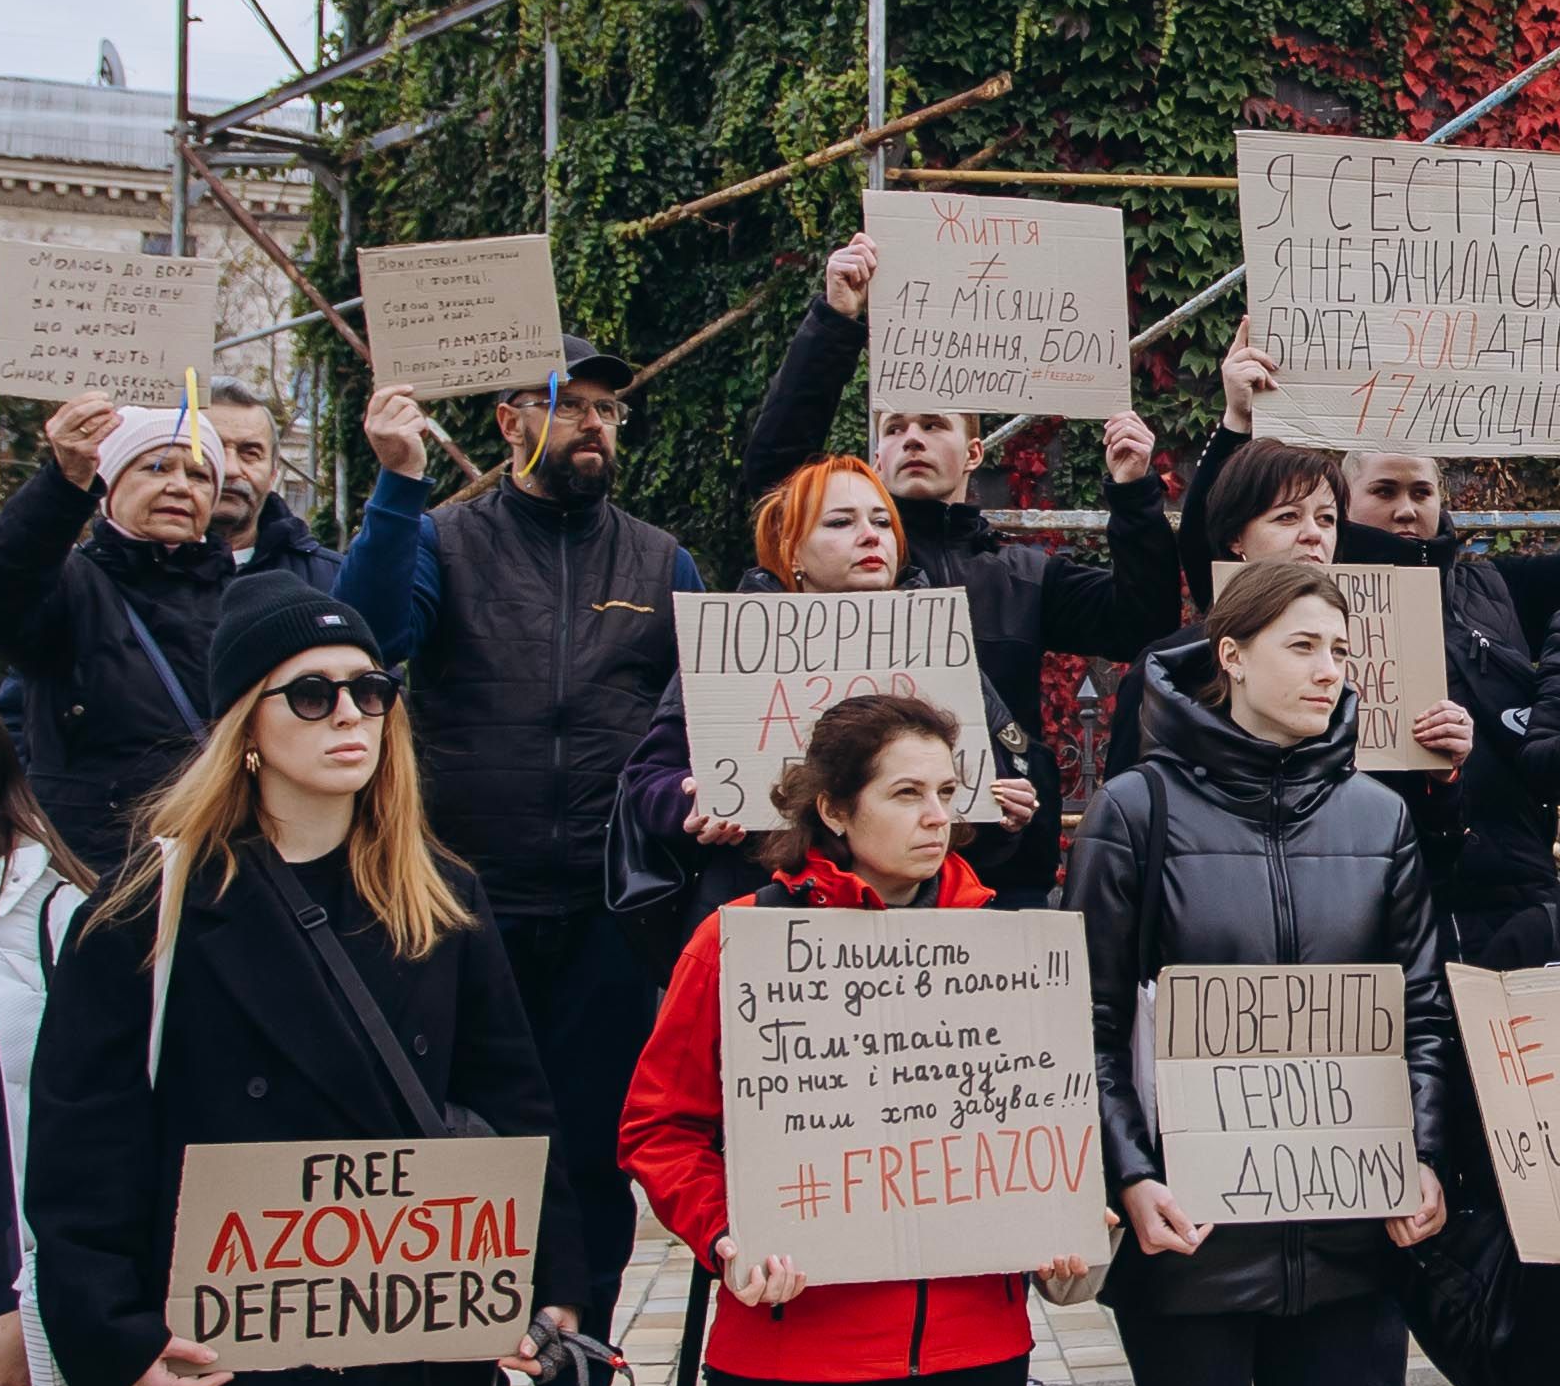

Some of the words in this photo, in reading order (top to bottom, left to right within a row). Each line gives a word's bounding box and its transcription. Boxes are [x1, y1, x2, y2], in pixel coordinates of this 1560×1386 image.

[1257, 154, 1294, 229] Я
[1328, 156, 1542, 235] СЕСТРА
[896, 281, 930, 319] 17
[1258, 237, 1295, 303] Я
[1310, 238, 1355, 303] НЕ
[1372, 238, 1502, 304] БАЧИЛА
[1265, 307, 1372, 372] БРАТА
[1383, 310, 1478, 371] 500
[1352, 370, 1415, 437] 17
[695, 592, 970, 674] ПОВЕРНІТЬ
[787, 920, 970, 972] Більшість
[738, 981, 756, 1022] з
[768, 980, 828, 1003] них
[844, 974, 903, 1016] досі
[916, 971, 931, 998] в
[945, 950, 1070, 996] полоні!!!
[1168, 974, 1393, 1057] ПОВЕРНІТЬ
[759, 1018, 1002, 1063] Пам'ятайте
[1489, 1016, 1554, 1086] НЕ
[737, 1076, 788, 1110] про
[799, 1074, 848, 1092] них
[869, 1067, 878, 1087] і
[893, 1050, 1055, 1094] нагадуйте
[785, 1114, 854, 1133] тим
[882, 1105, 937, 1124] хто
[950, 1073, 1092, 1129] забуває!!!
[1213, 1059, 1352, 1131] ГЕРОЇВ
[302, 1148, 416, 1202] FREE
[778, 1125, 1093, 1220] #FREEAZOV
[1221, 1142, 1406, 1214] ДОДОМУ
[206, 1197, 530, 1276] AZOVSTAL
[195, 1269, 522, 1343] DEFENDERS
